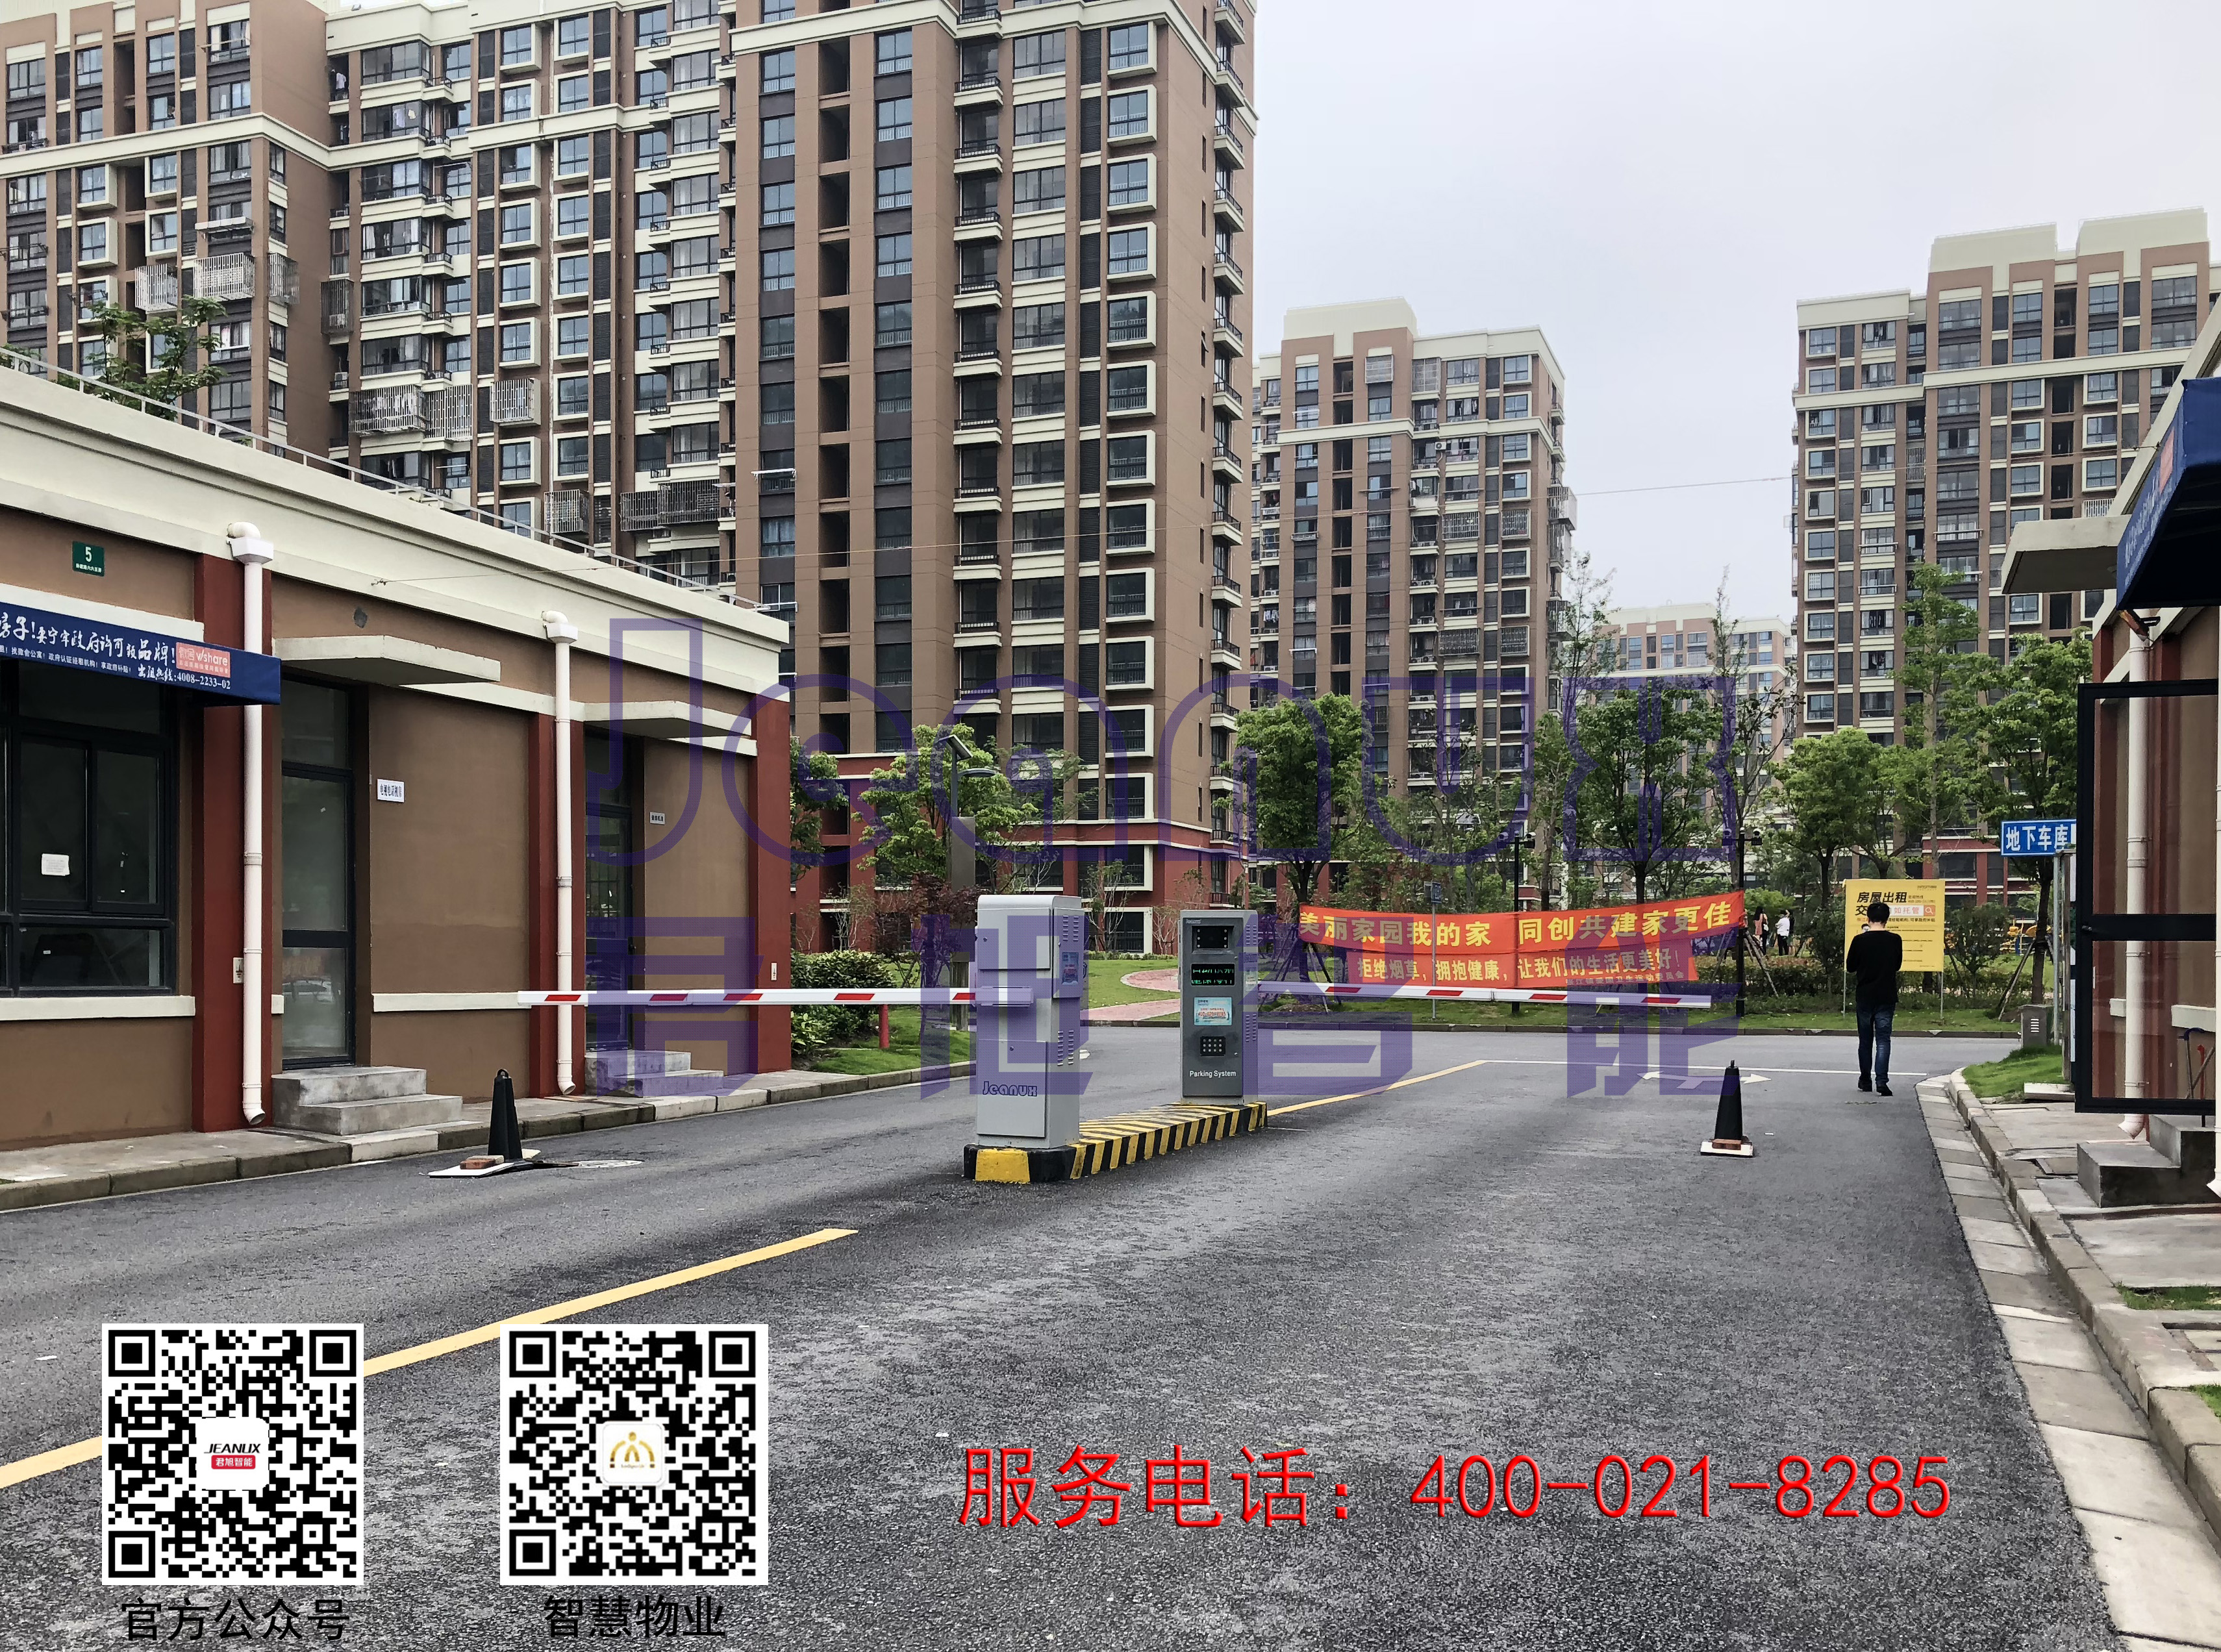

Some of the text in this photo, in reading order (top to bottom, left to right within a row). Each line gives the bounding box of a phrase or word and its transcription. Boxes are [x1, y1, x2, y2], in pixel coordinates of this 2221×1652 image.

[85, 546, 92, 562] 5
[2005, 824, 2069, 851] 地下车库
[1857, 892, 1907, 903] 房屋出租
[1299, 900, 1732, 947] 美丽家园我的家 同创共建家更佳
[982, 1081, 1037, 1097] Jeanux
